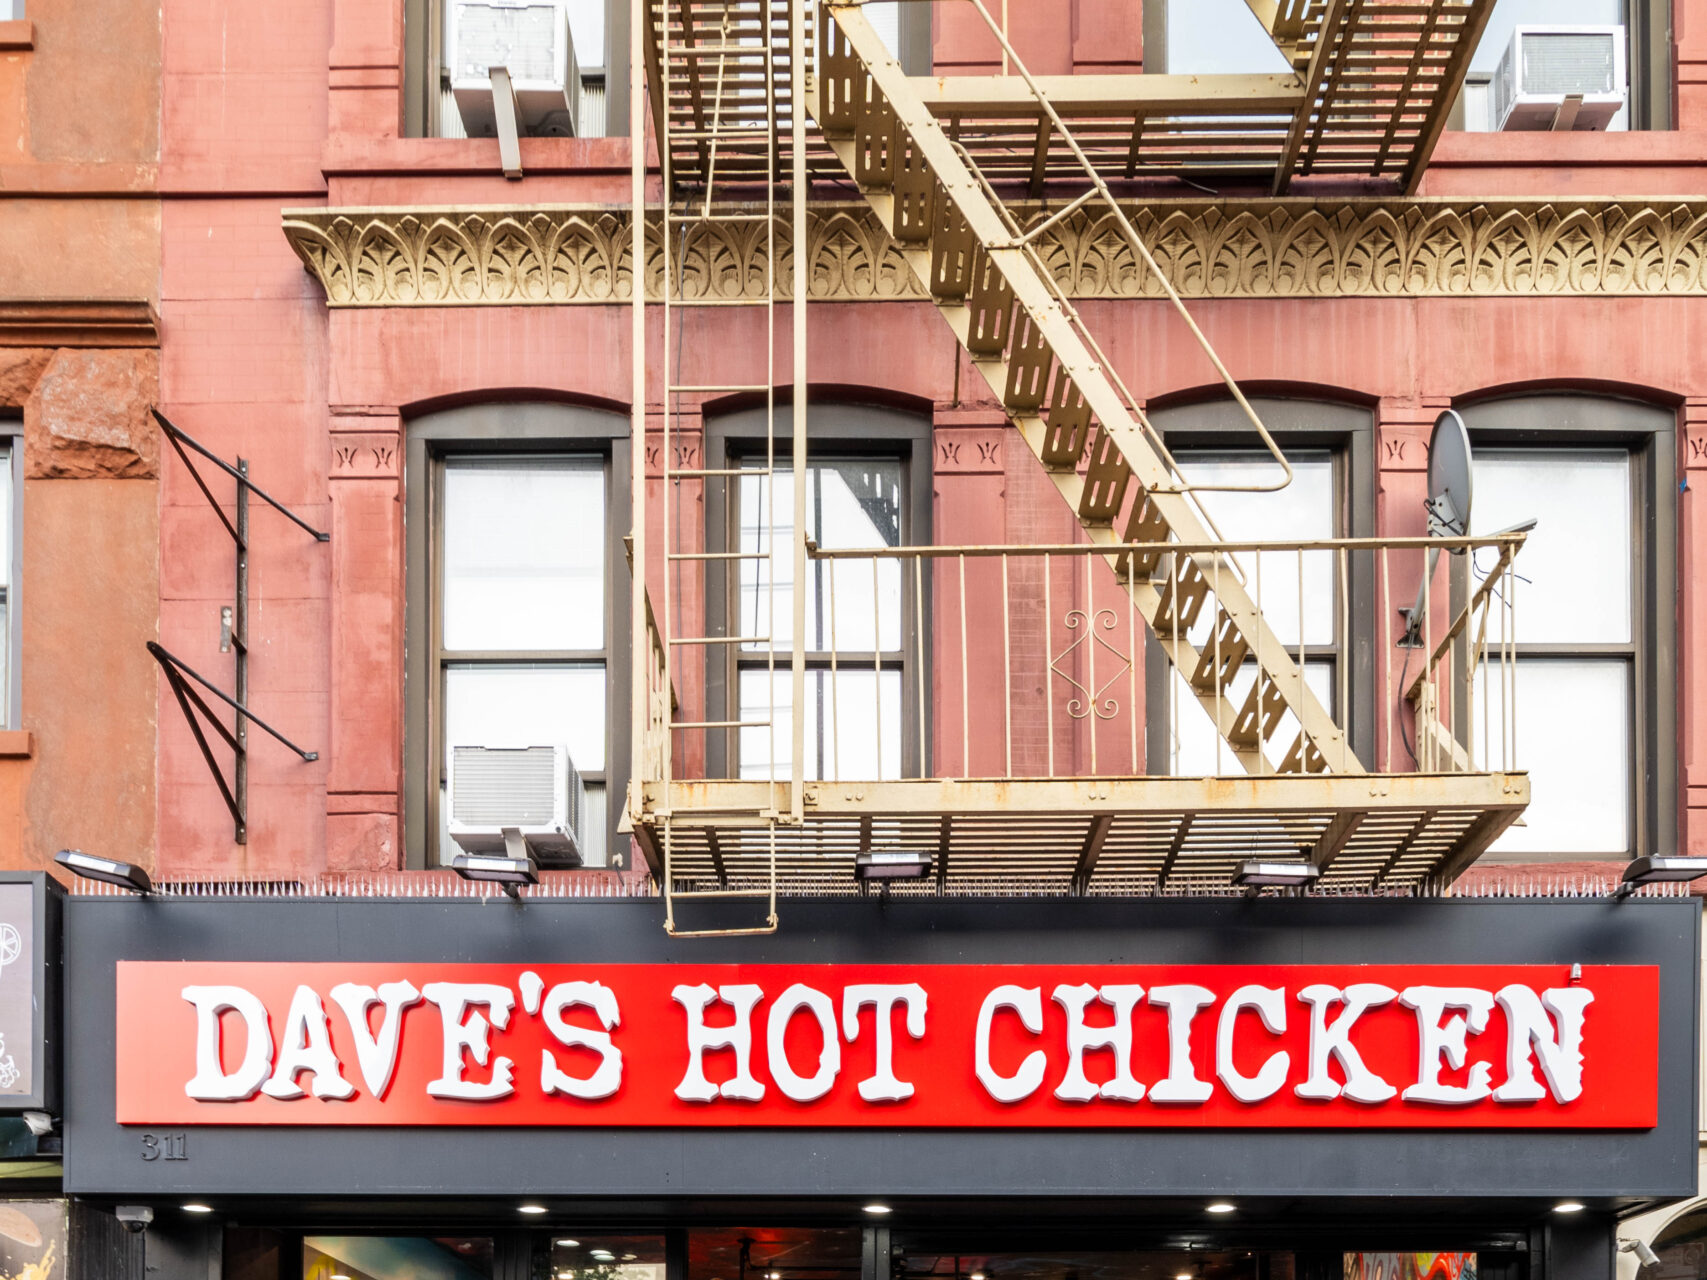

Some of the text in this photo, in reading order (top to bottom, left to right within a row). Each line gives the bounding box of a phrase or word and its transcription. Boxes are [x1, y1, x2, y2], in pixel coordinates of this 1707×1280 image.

[181, 970, 1591, 1105] DAVE'S HOT CHICKEN
[140, 1132, 189, 1161] 311
